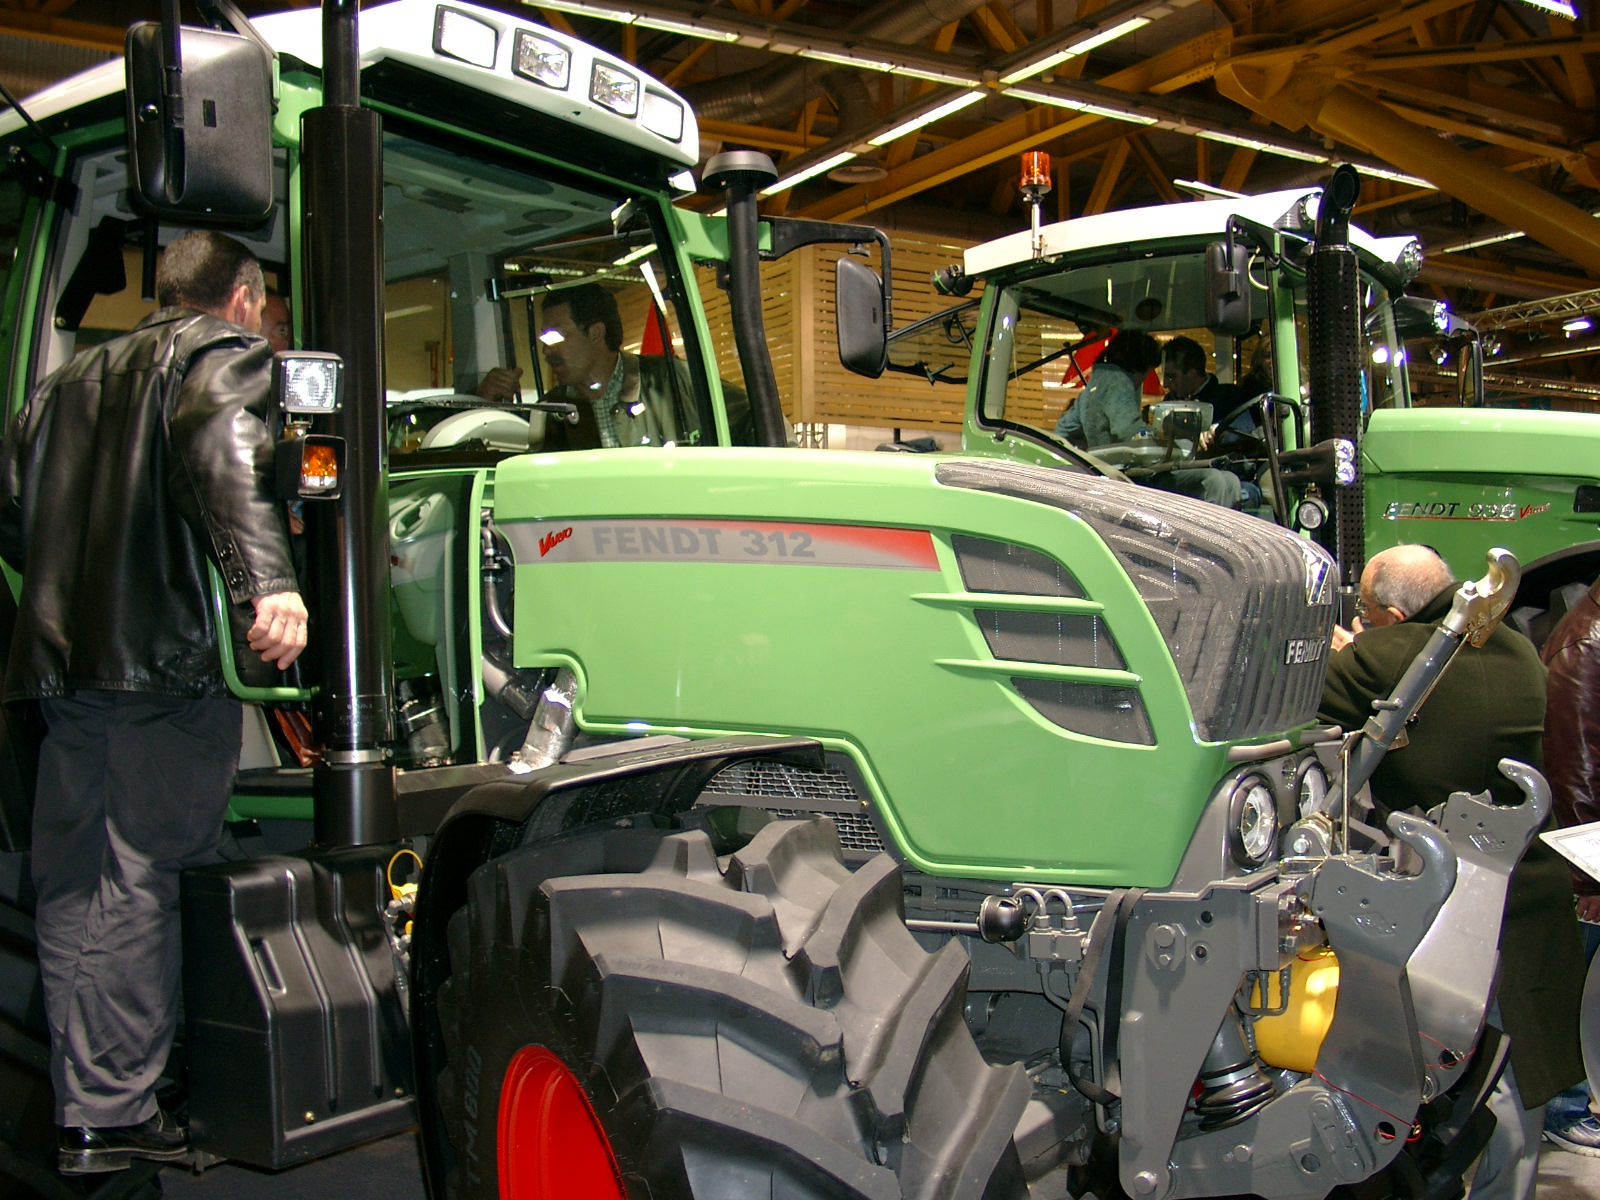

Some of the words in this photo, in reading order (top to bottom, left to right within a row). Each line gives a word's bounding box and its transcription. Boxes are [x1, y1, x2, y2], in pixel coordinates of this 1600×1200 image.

[1383, 502, 1461, 518] FENDT
[1468, 503, 1517, 518] 936
[591, 526, 722, 556] FENDT
[739, 528, 816, 558] 312
[1286, 637, 1326, 666] FENDT
